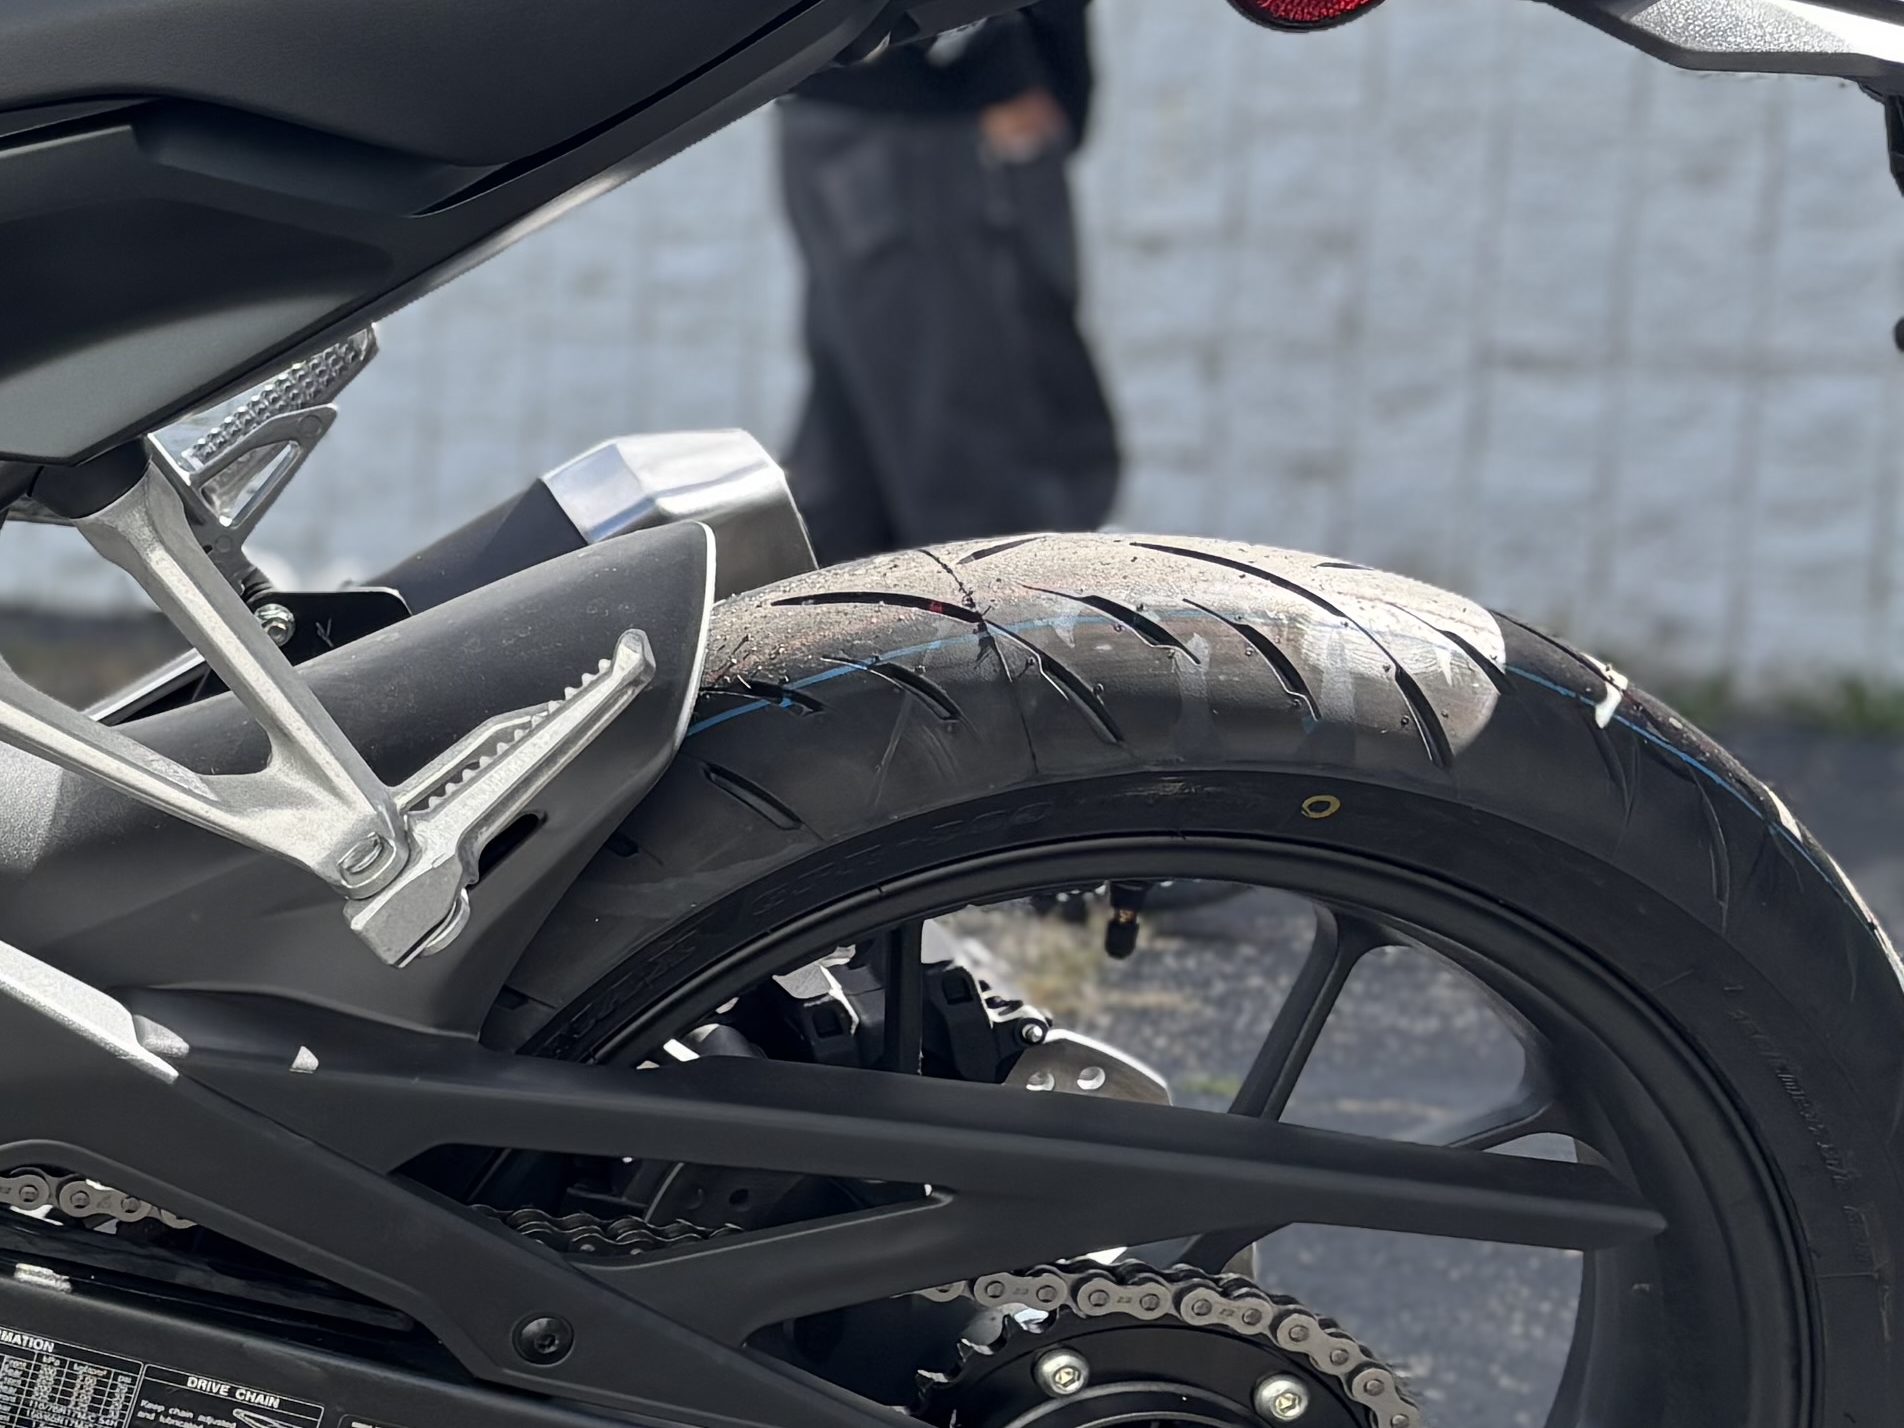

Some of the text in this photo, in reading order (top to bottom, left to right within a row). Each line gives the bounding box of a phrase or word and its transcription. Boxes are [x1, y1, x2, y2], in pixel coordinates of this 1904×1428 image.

[186, 1376, 281, 1409] DRIVE CHAIN
[137, 1411, 156, 1421] and
[141, 1399, 165, 1412] Keep
[168, 1407, 194, 1419] chain
